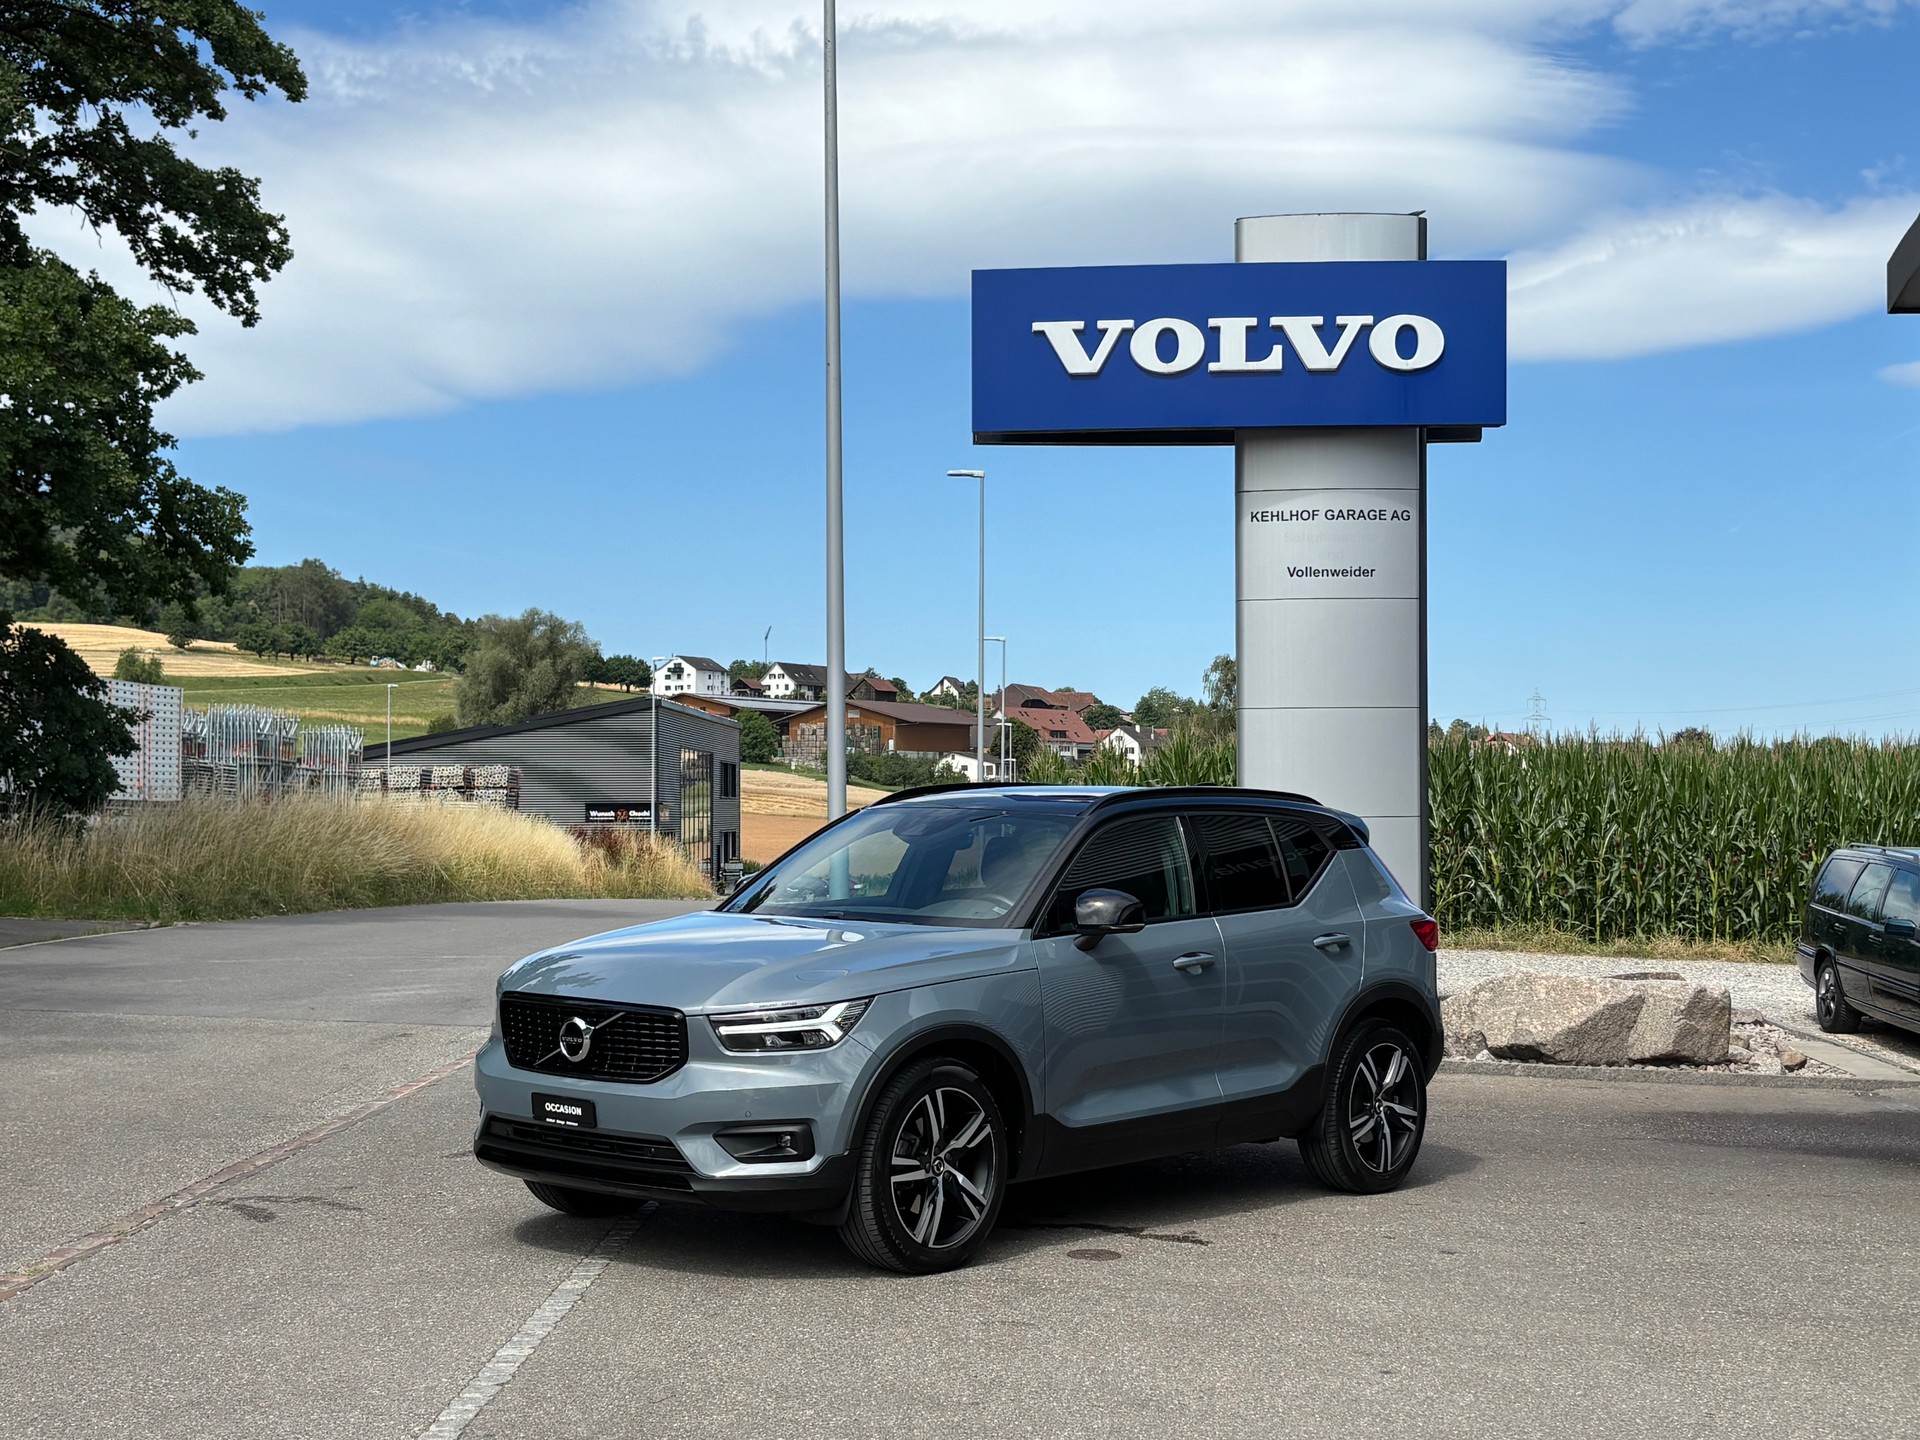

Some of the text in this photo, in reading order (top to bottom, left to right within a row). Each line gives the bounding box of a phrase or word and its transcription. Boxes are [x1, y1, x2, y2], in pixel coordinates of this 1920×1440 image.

[1032, 314, 1445, 376] VOLVO
[1250, 509, 1411, 523] KEHLHOF GARAGE AG
[1287, 566, 1376, 578] Vollenweider
[545, 1102, 582, 1116] OCCASION
